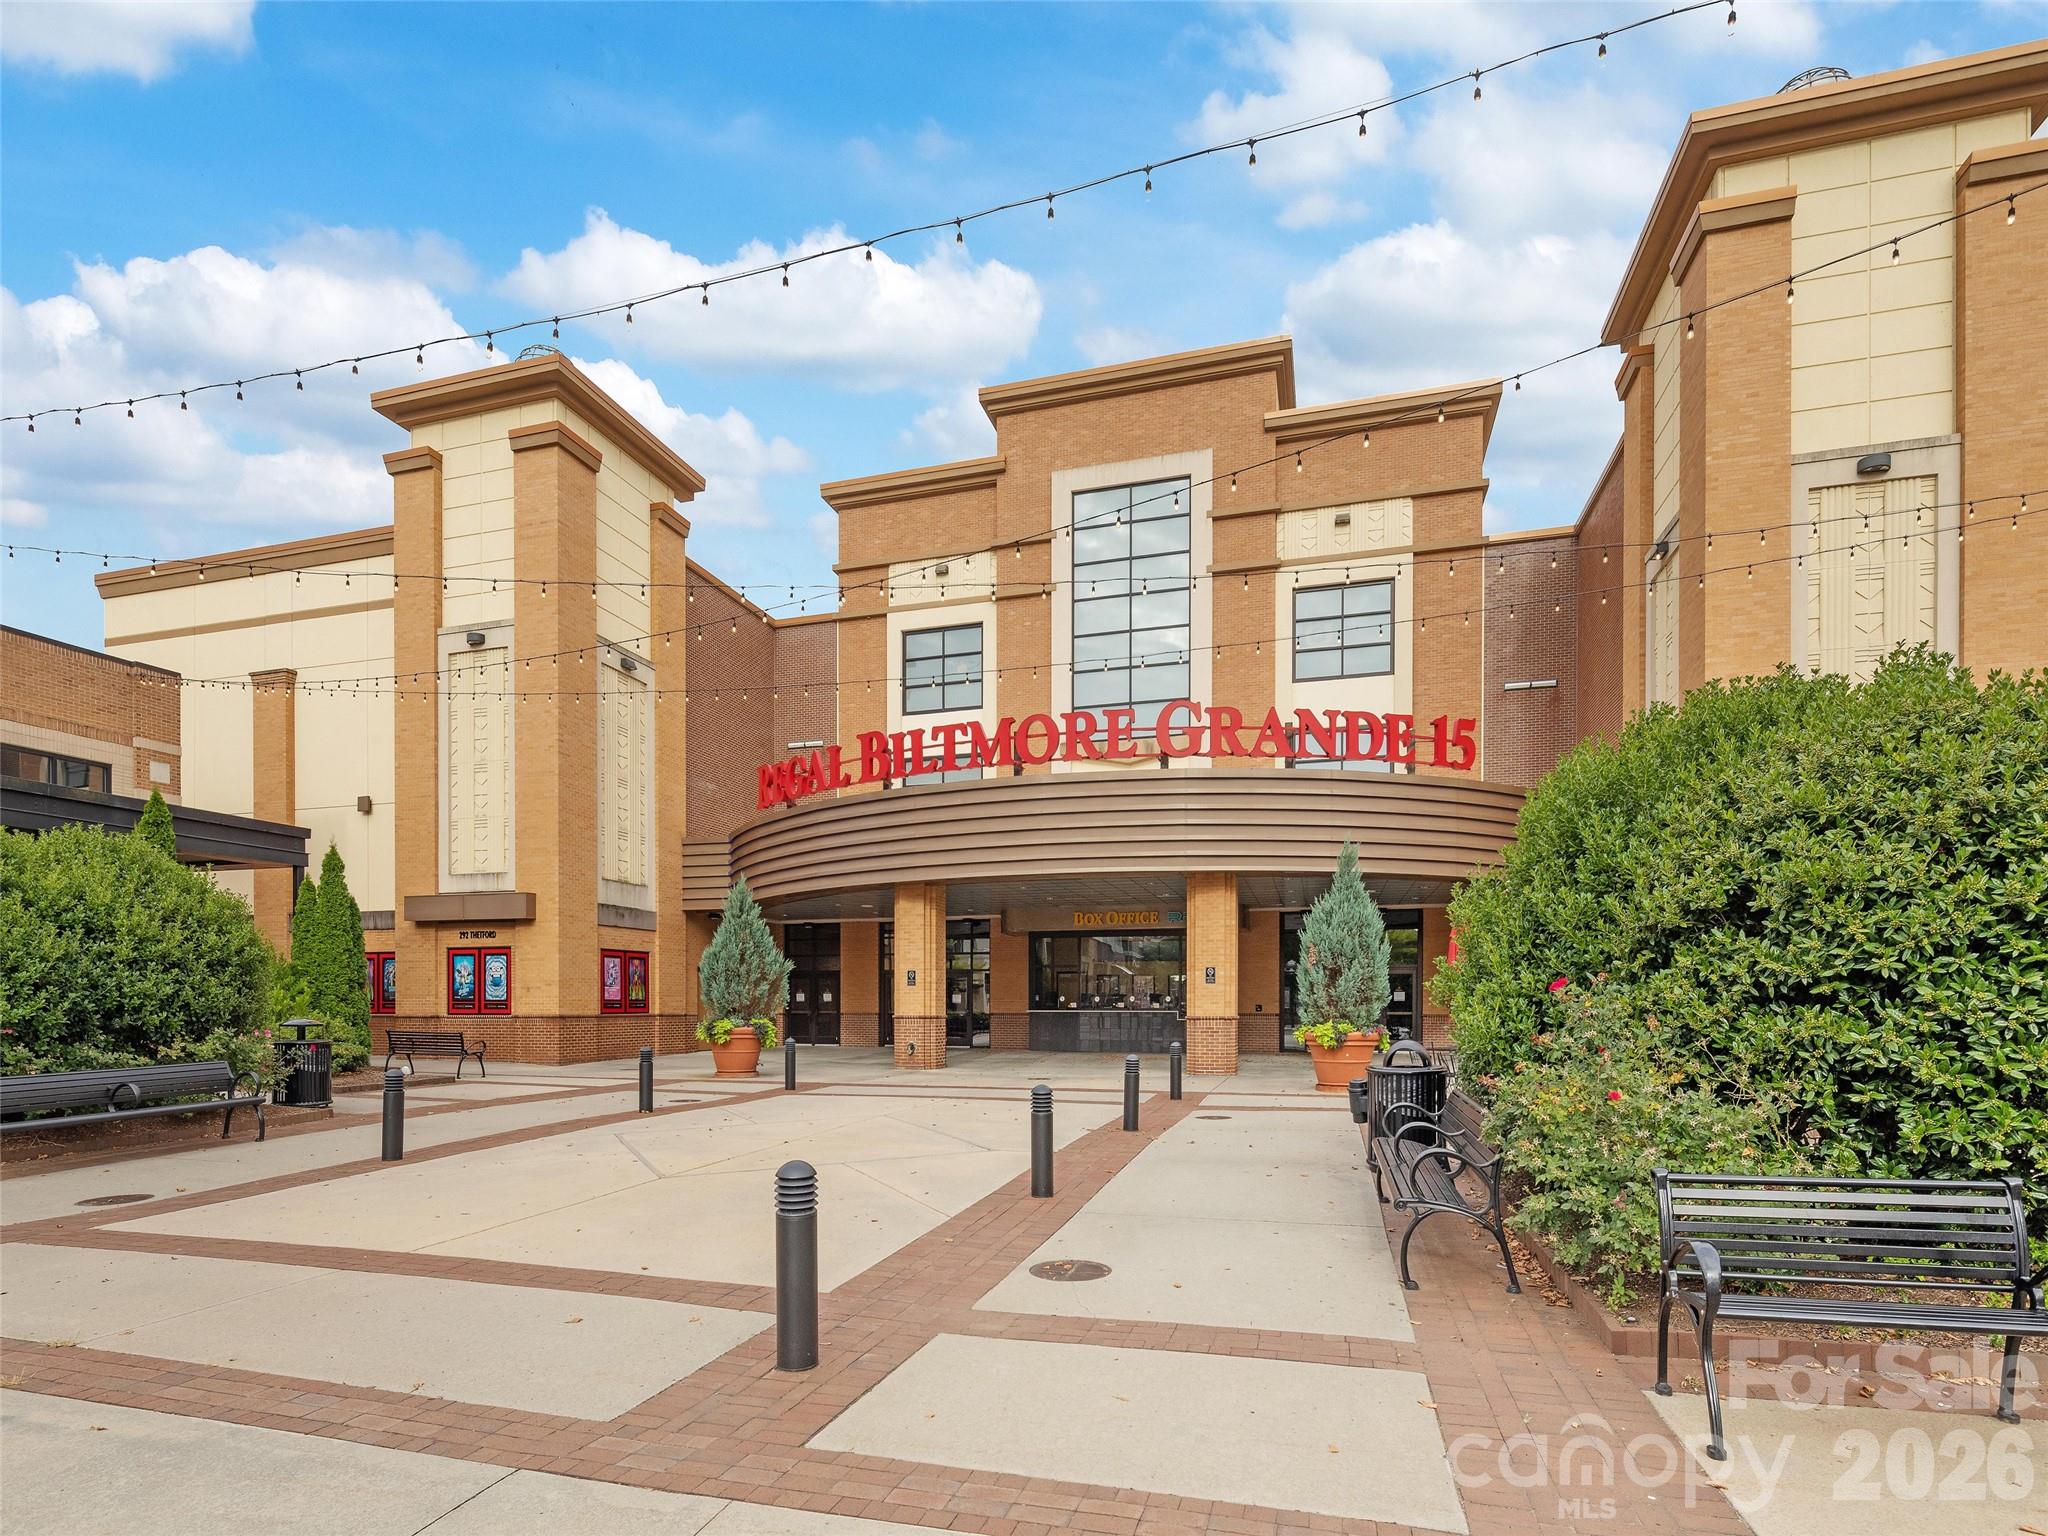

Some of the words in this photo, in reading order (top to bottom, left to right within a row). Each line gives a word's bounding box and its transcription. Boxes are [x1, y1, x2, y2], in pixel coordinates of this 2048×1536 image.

[757, 744, 852, 811] REGAL
[856, 708, 1138, 784] BILTMORE
[1156, 698, 1416, 763] GRANDE
[1430, 714, 1477, 770] 15
[1073, 911, 1104, 927] BOX
[1105, 911, 1159, 926] OFFICE
[459, 931, 469, 939] 292
[470, 930, 496, 939] THETFORD
